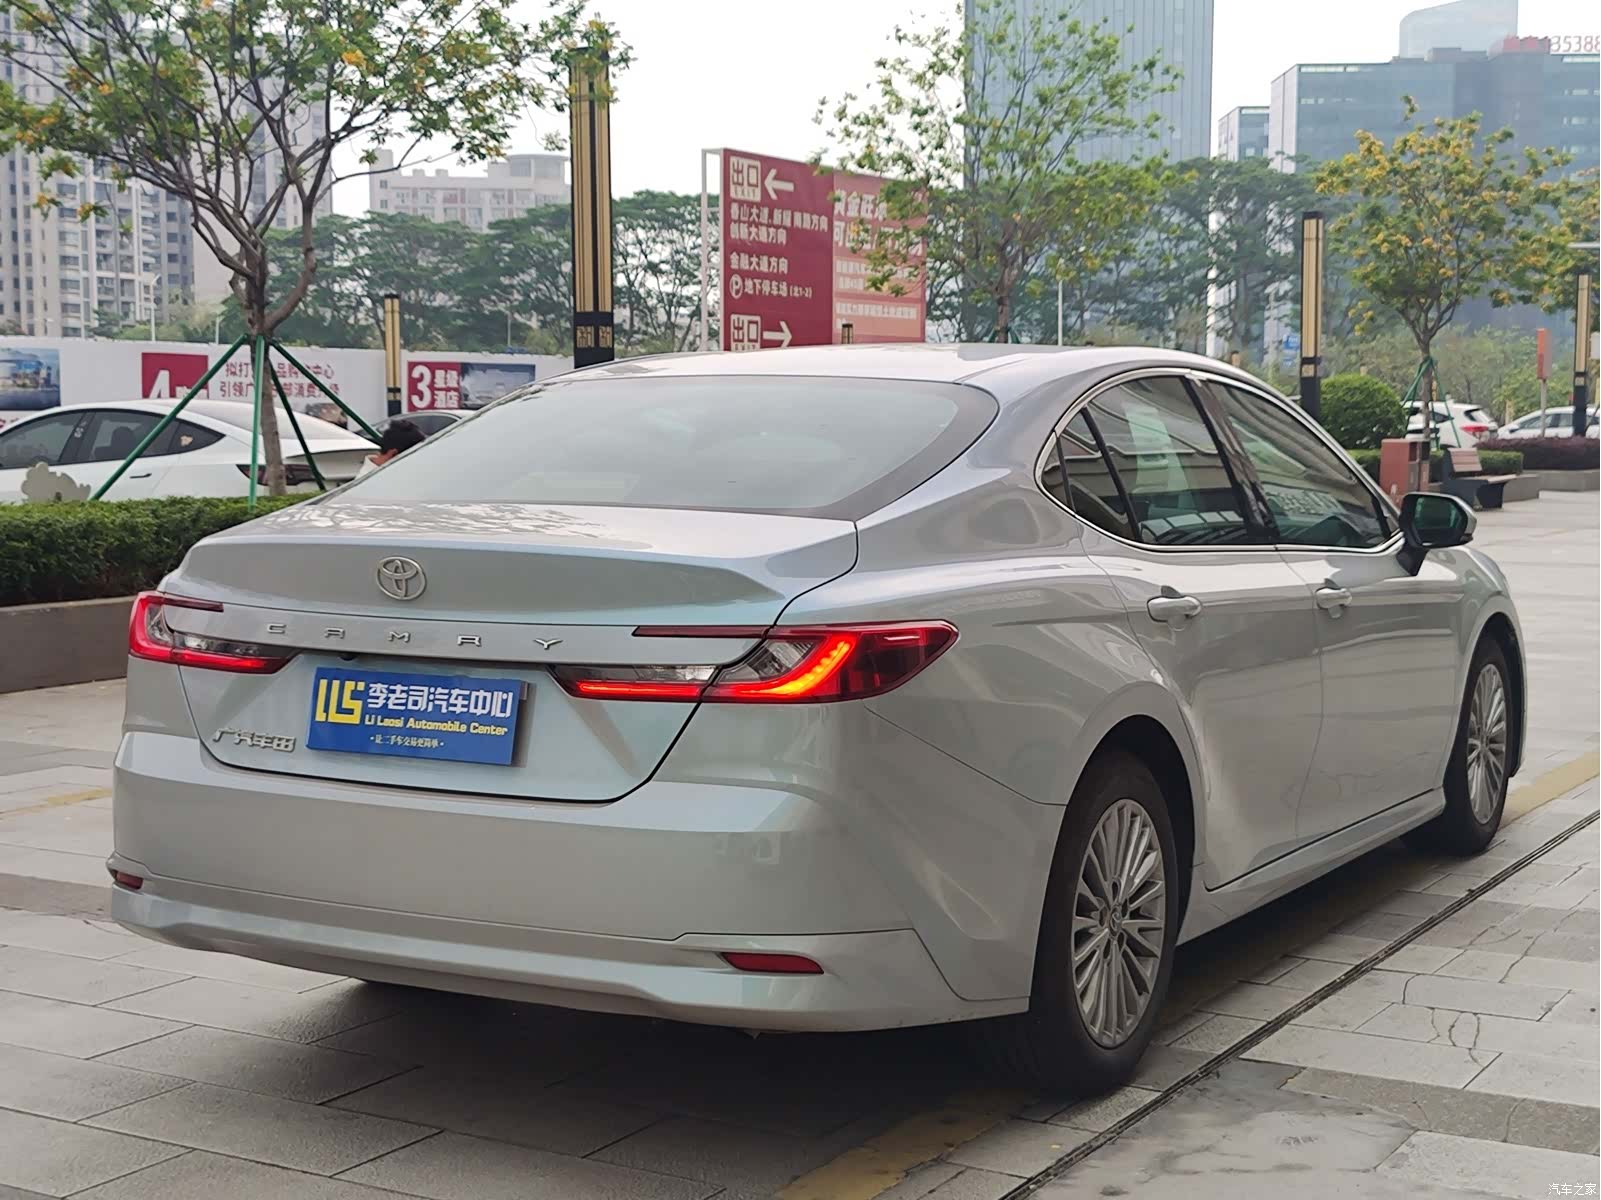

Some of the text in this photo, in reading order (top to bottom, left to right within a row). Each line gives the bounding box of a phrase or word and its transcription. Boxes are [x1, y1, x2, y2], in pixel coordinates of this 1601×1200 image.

[731, 159, 759, 188] 出口
[729, 251, 789, 275] 金融大道方向
[744, 277, 788, 297] 地下停车场
[732, 317, 759, 343] 出口
[411, 364, 459, 409] 3 星级
[434, 390, 460, 409] 酒店
[268, 623, 562, 649] CAMRY
[366, 682, 514, 718] 李老司汽车中心
[364, 714, 508, 736] Li Laosi Automobile Center
[213, 727, 296, 753] 广汽丰田
